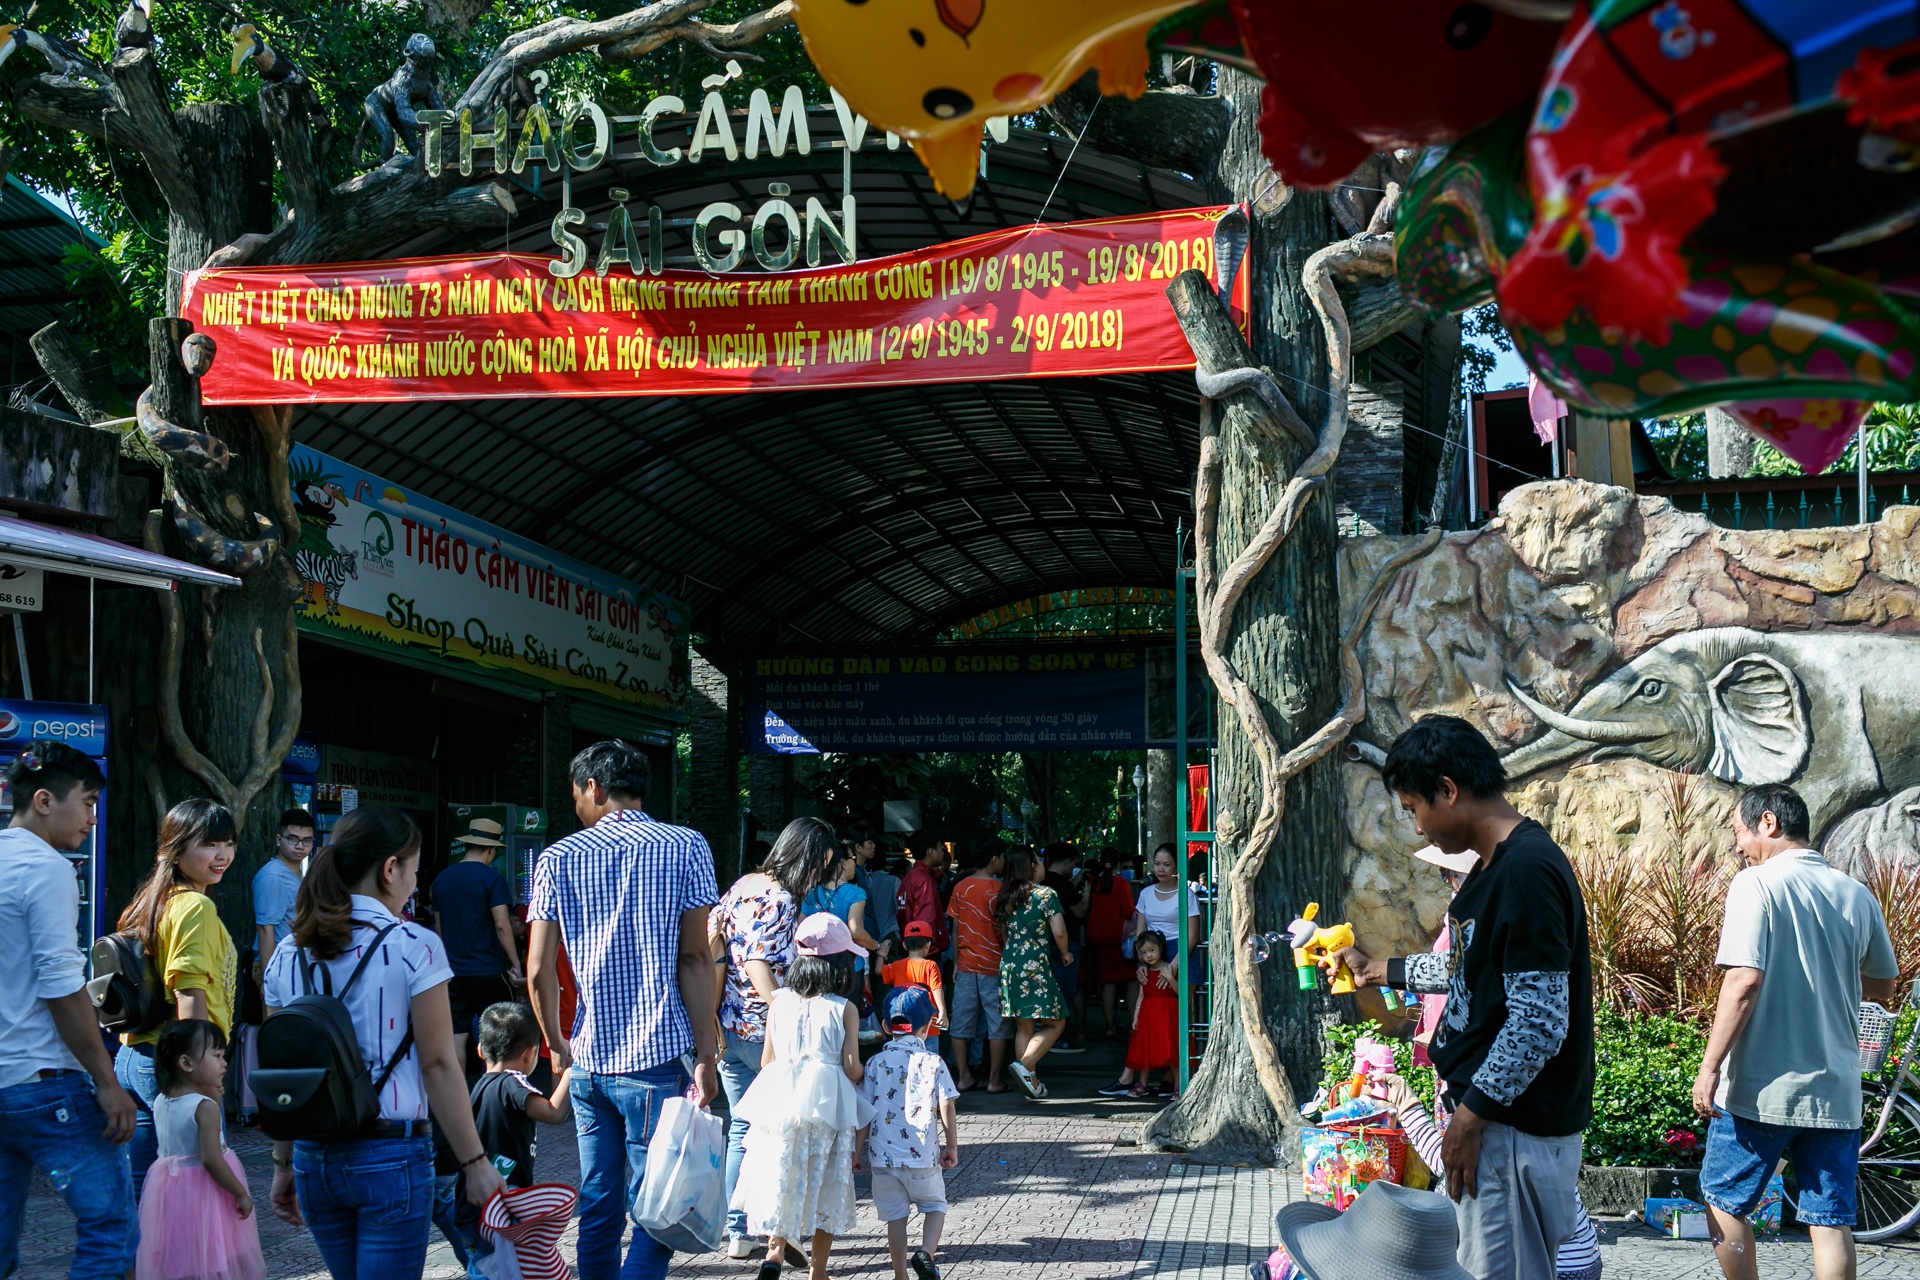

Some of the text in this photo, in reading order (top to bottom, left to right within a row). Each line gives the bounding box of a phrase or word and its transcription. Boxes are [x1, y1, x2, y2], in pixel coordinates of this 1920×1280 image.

[416, 69, 610, 178] THẢO
[638, 59, 812, 167] CẦM
[202, 282, 257, 332] NHIỆT
[260, 280, 301, 331] LIỆT
[305, 278, 354, 323] CHÀO
[359, 275, 413, 320] MỪNG
[418, 281, 442, 318] 73
[447, 272, 491, 316] NĂM
[496, 269, 549, 314] NGÀY
[874, 261, 934, 301] CÔNG
[941, 250, 1064, 301] (19/8/1945
[1087, 236, 1214, 285] 19/8/2018)
[271, 337, 295, 381] VÀ
[300, 331, 350, 387] QUỐC
[355, 333, 419, 379] KHÁNH
[425, 331, 476, 377] NƯỚC
[481, 329, 533, 382] CỘNG
[538, 326, 578, 373] HOÀ
[583, 327, 610, 373] XÃ
[617, 327, 653, 379] HỘI
[657, 319, 699, 370] CHỦ
[705, 323, 768, 369] NGHĨA
[774, 320, 821, 374] VIỆT
[826, 328, 874, 365] NAM
[880, 317, 989, 366] (2/9/1945
[1010, 309, 1123, 352] 2/9/2018)
[401, 517, 639, 635] THẢO CẦM VIÊN SÀI GÒN
[15, 595, 36, 607] 619
[386, 593, 649, 695] Shop Quà Sài Gòn Zoo
[786, 683, 799, 693] du
[801, 682, 830, 693] khách
[824, 700, 843, 709] khe
[33, 719, 95, 740] pepsi
[765, 717, 785, 727] Đèn
[898, 716, 911, 726] du
[913, 715, 943, 726] khách
[945, 714, 956, 726] đi
[958, 717, 977, 728] qua
[1005, 715, 1032, 727] trong
[1034, 714, 1059, 727] vòng
[1061, 713, 1075, 723] 30
[1076, 712, 1099, 726] giây
[765, 733, 799, 747] Trường
[851, 733, 864, 743] du
[866, 732, 896, 743] khách
[898, 734, 923, 746] quay
[924, 734, 936, 743] ra
[937, 732, 960, 743] theo
[1080, 730, 1106, 741] nhân
[1108, 729, 1132, 740] viên
[291, 744, 317, 760] pepsi
